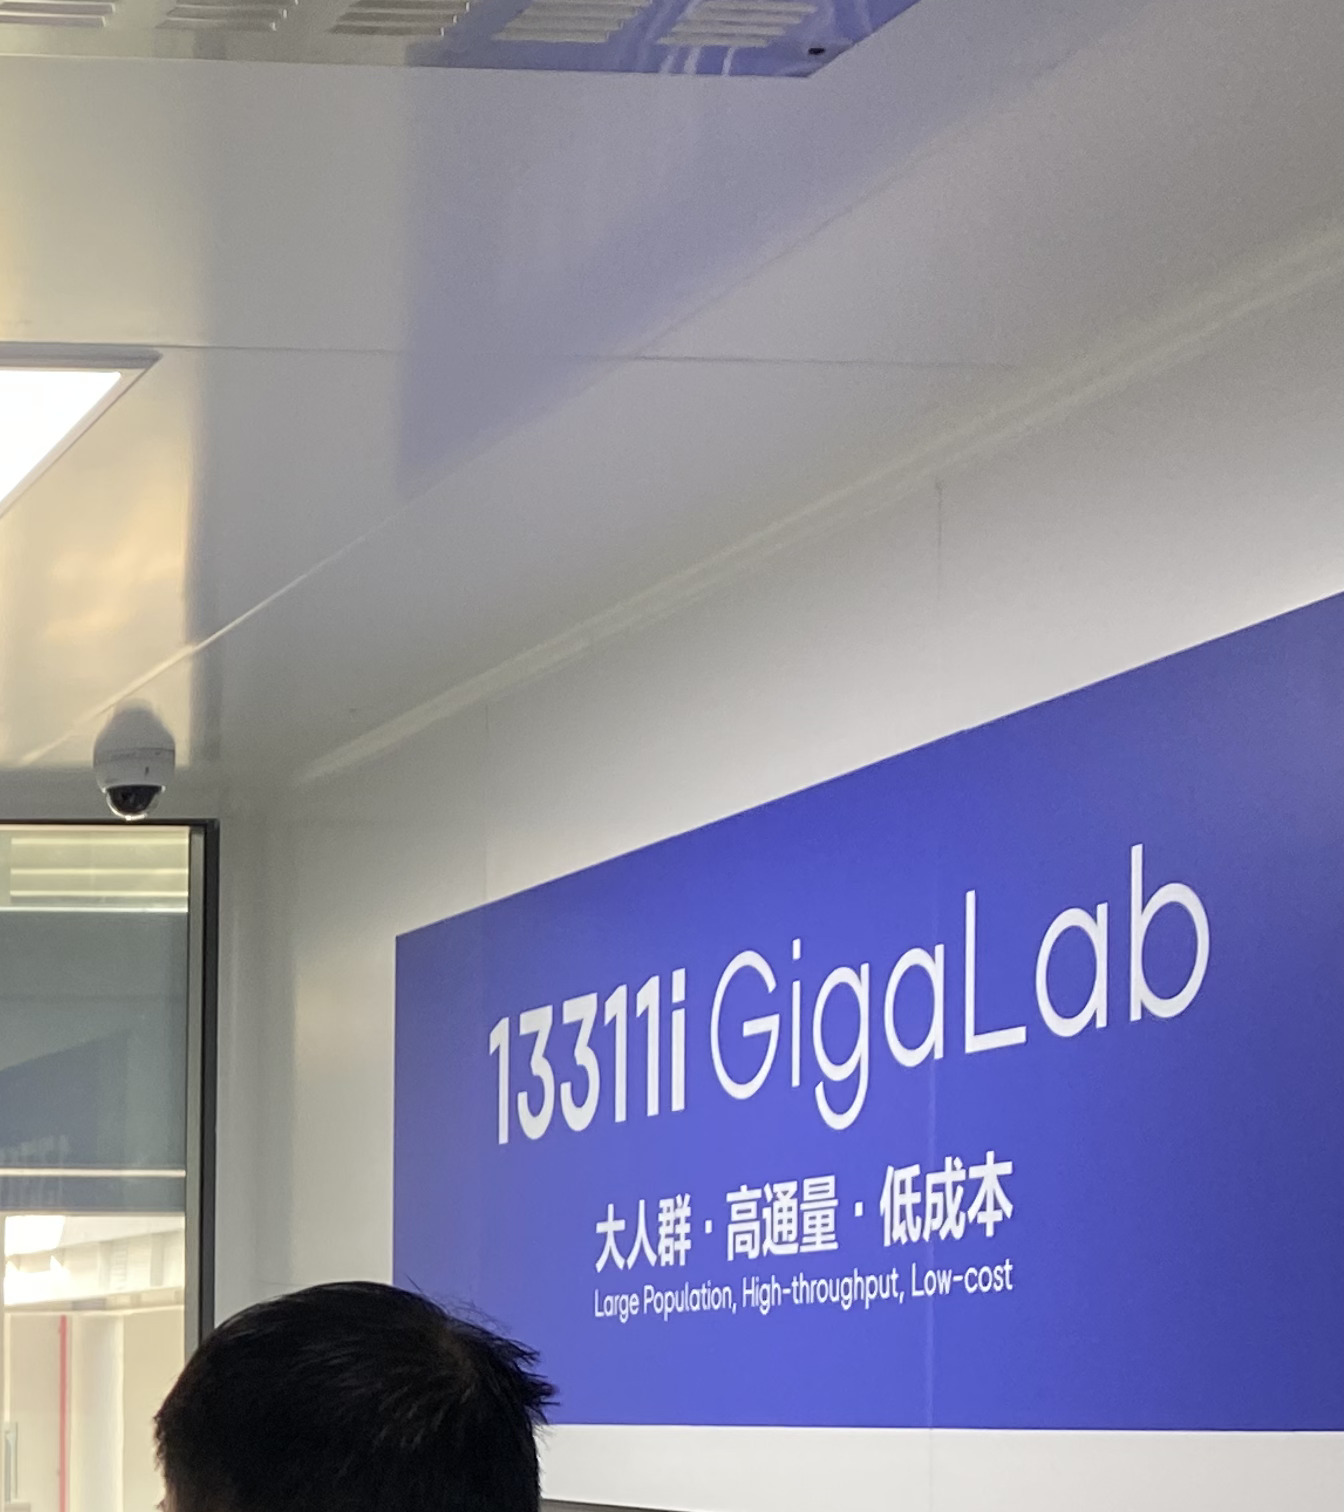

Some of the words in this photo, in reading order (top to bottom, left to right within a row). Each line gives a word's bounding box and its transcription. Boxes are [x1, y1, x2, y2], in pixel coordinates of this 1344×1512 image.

[711, 844, 1211, 1131] GigaLab
[594, 1289, 640, 1323] Large
[643, 1280, 737, 1321] Population,
[742, 1268, 904, 1315] High-throughput,
[911, 1258, 1014, 1297] Low-cost
